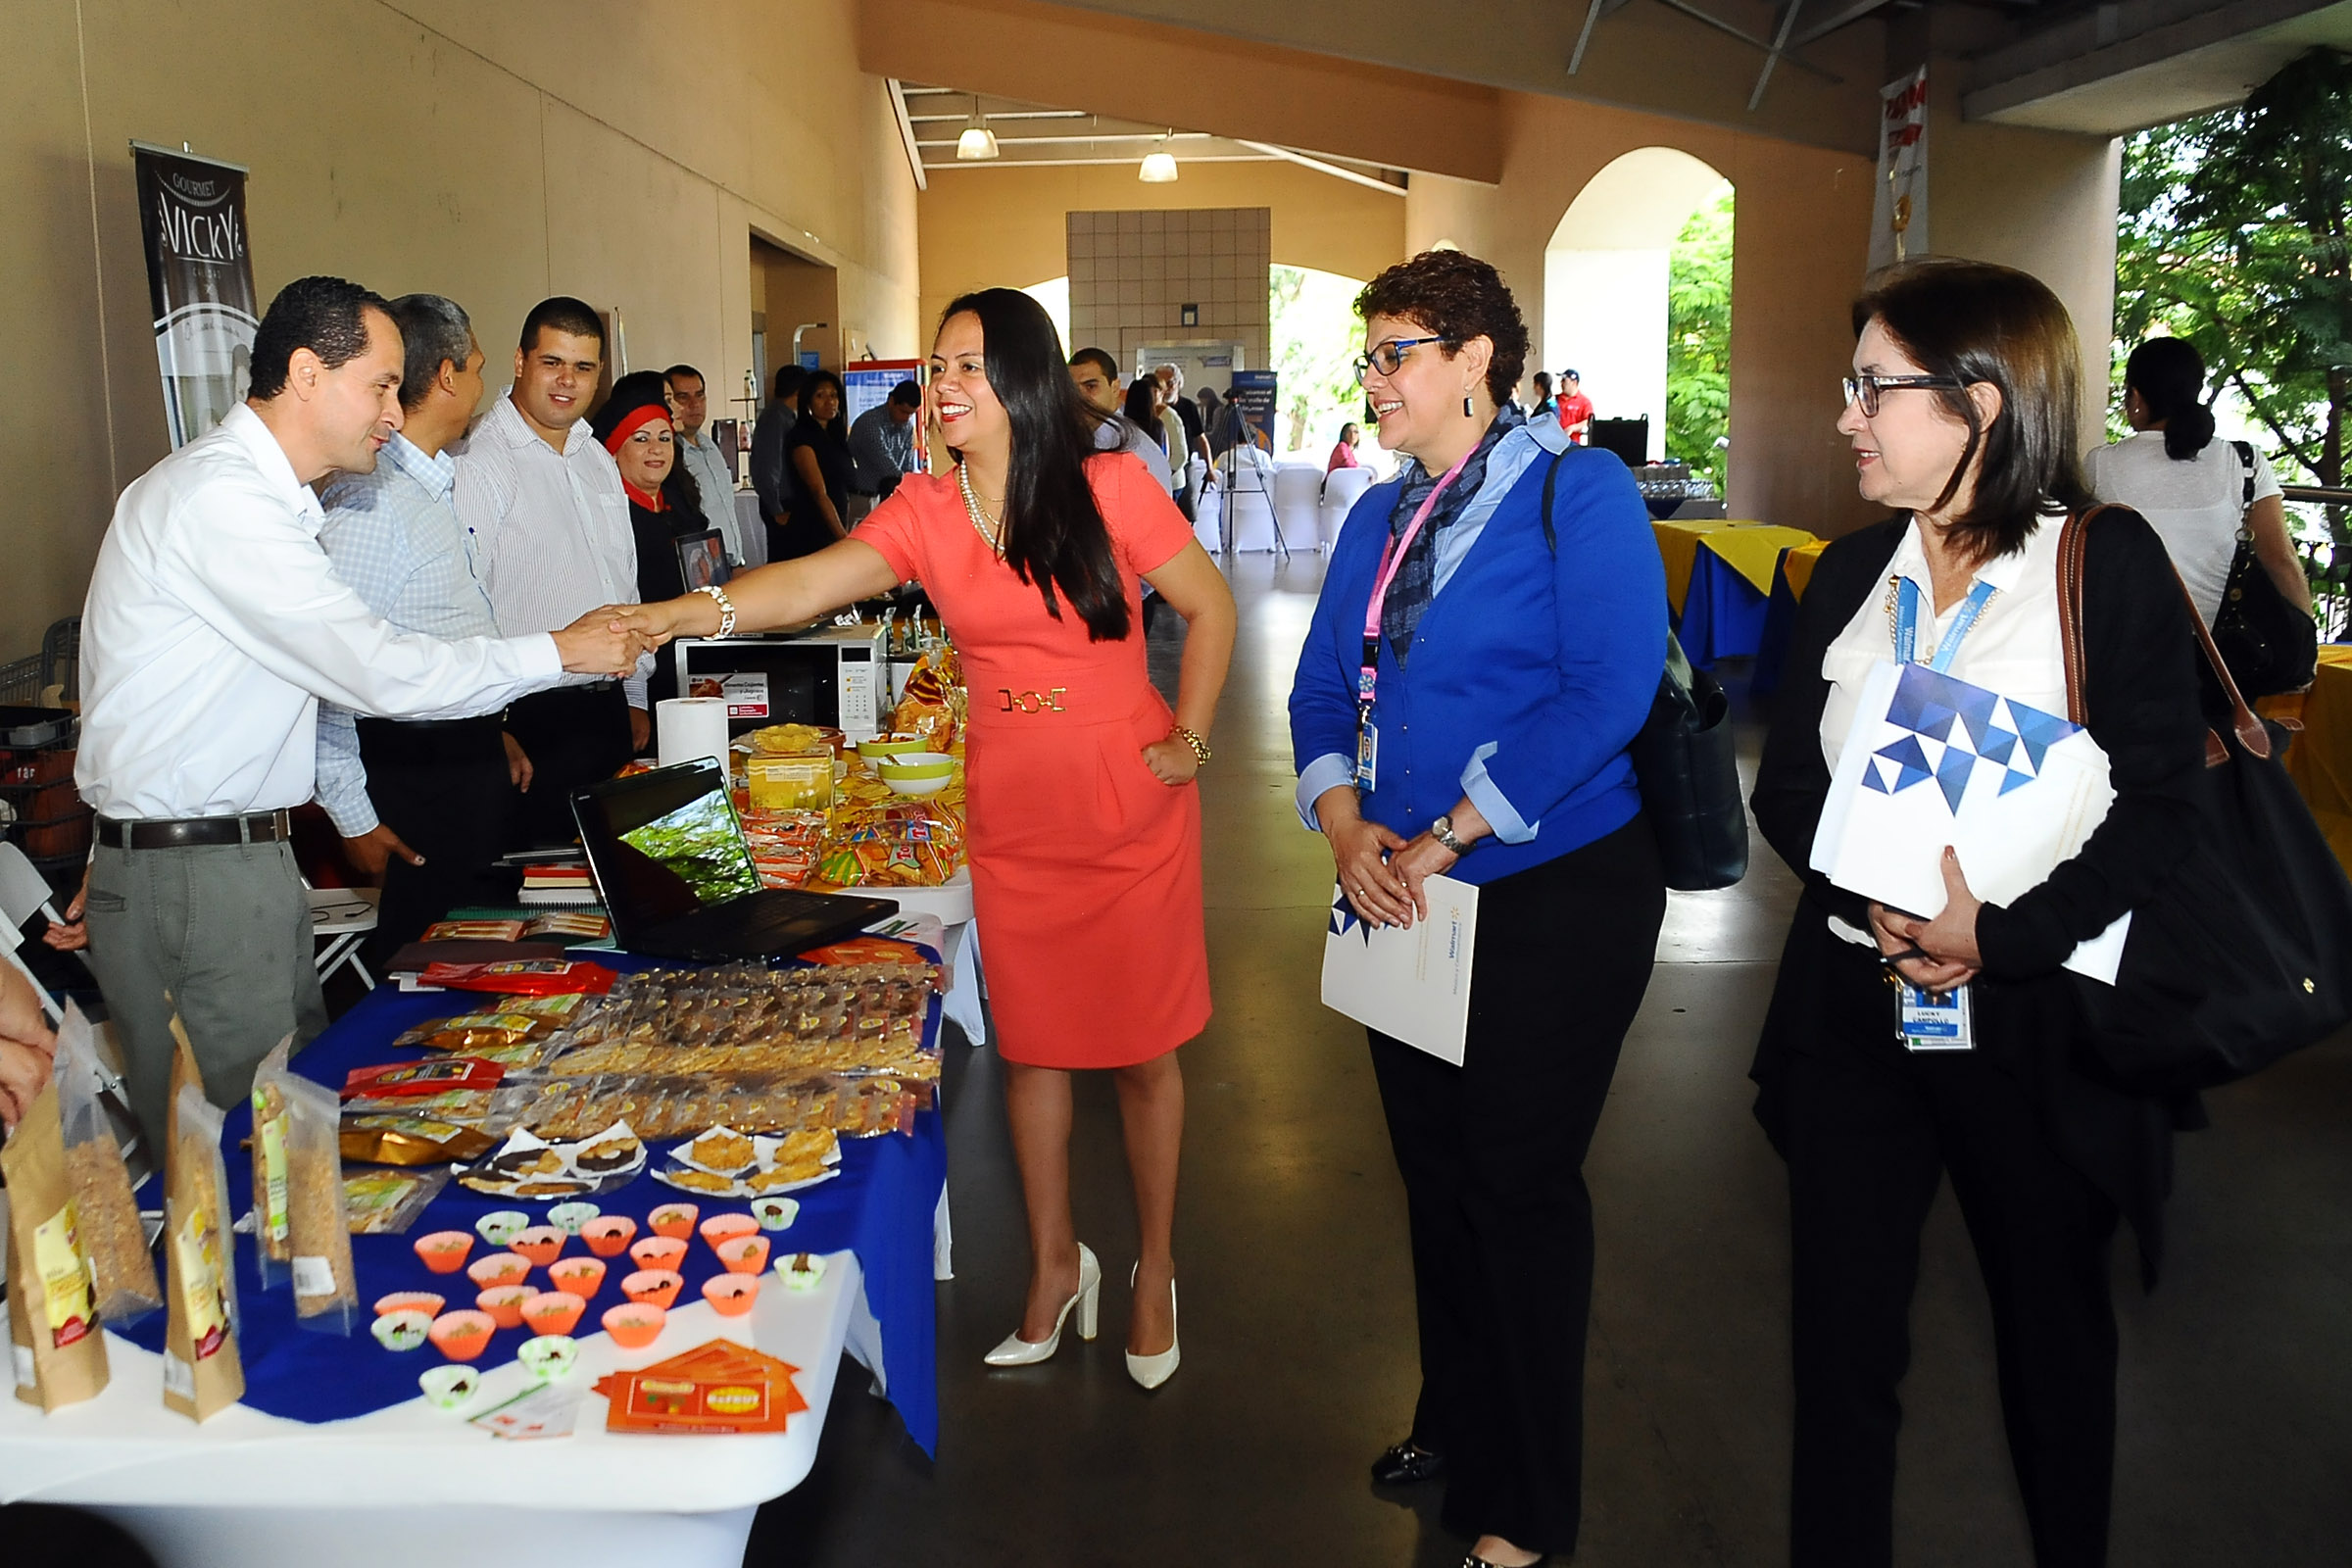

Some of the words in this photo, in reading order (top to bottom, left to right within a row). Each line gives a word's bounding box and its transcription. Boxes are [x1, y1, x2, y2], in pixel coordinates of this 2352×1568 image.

[172, 172, 216, 196] GOURMET
[1903, 626, 1914, 662] Walmar
[1940, 613, 1969, 653] Walmart
[1448, 921, 1457, 958] Walmart
